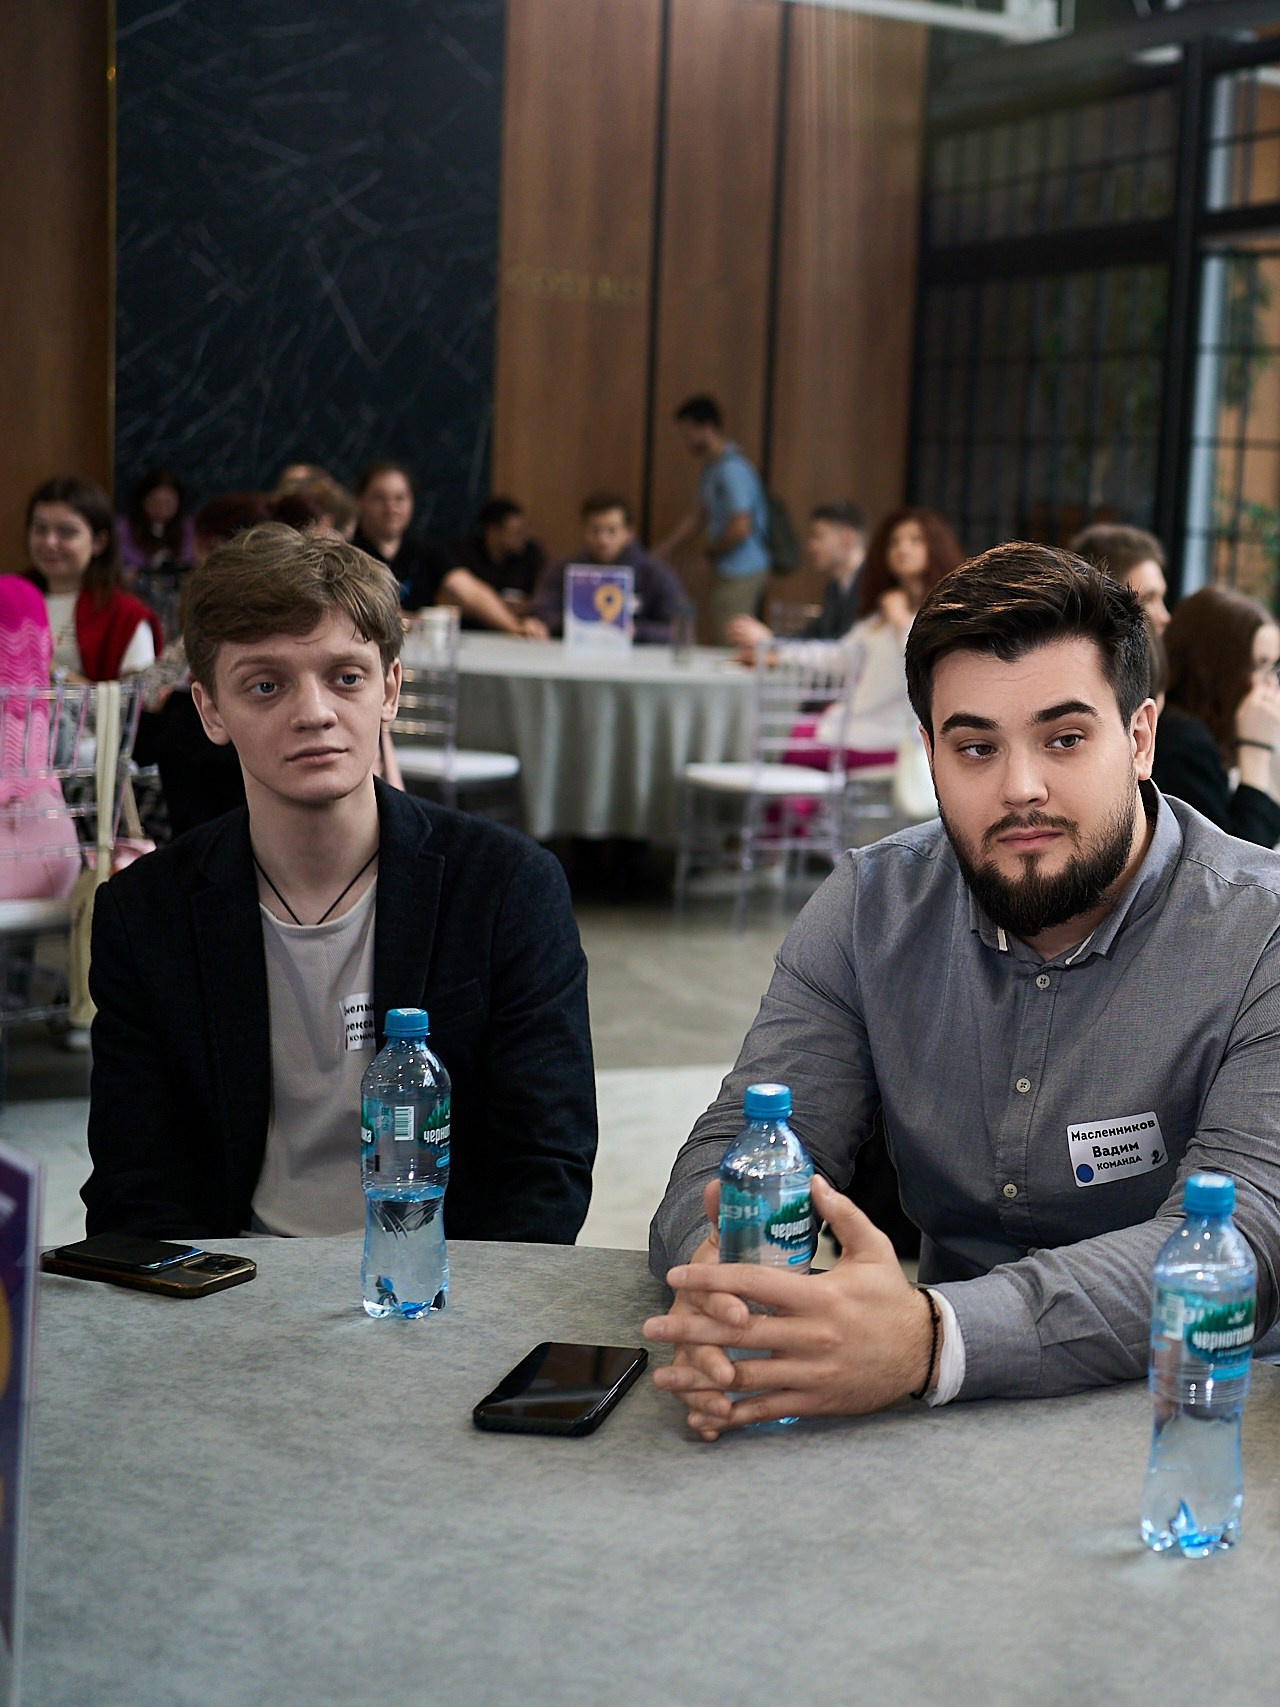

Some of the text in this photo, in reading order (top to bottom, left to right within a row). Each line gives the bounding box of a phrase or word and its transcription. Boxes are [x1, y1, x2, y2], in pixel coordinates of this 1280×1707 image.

[1071, 1120, 1155, 1141] Масленников
[1092, 1142, 1139, 1158] Вадим
[1097, 1155, 1142, 1170] КОМАНДА
